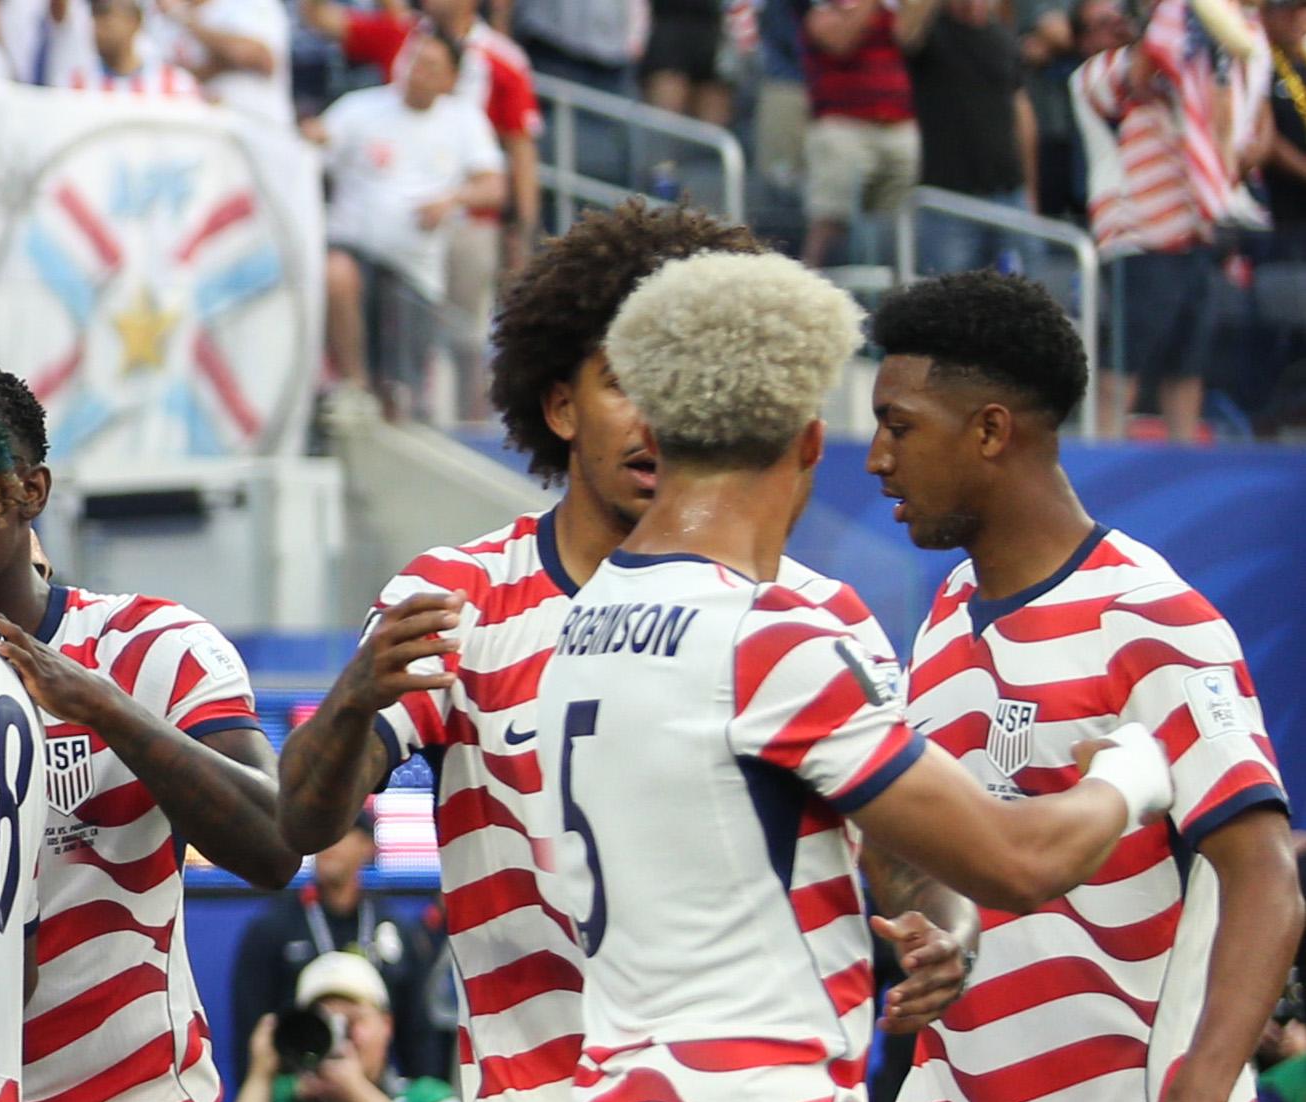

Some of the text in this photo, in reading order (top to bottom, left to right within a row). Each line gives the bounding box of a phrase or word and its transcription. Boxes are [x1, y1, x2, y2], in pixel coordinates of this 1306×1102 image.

[557, 603, 700, 656] ROBINSON
[996, 703, 1031, 732] USA
[560, 699, 608, 958] 5
